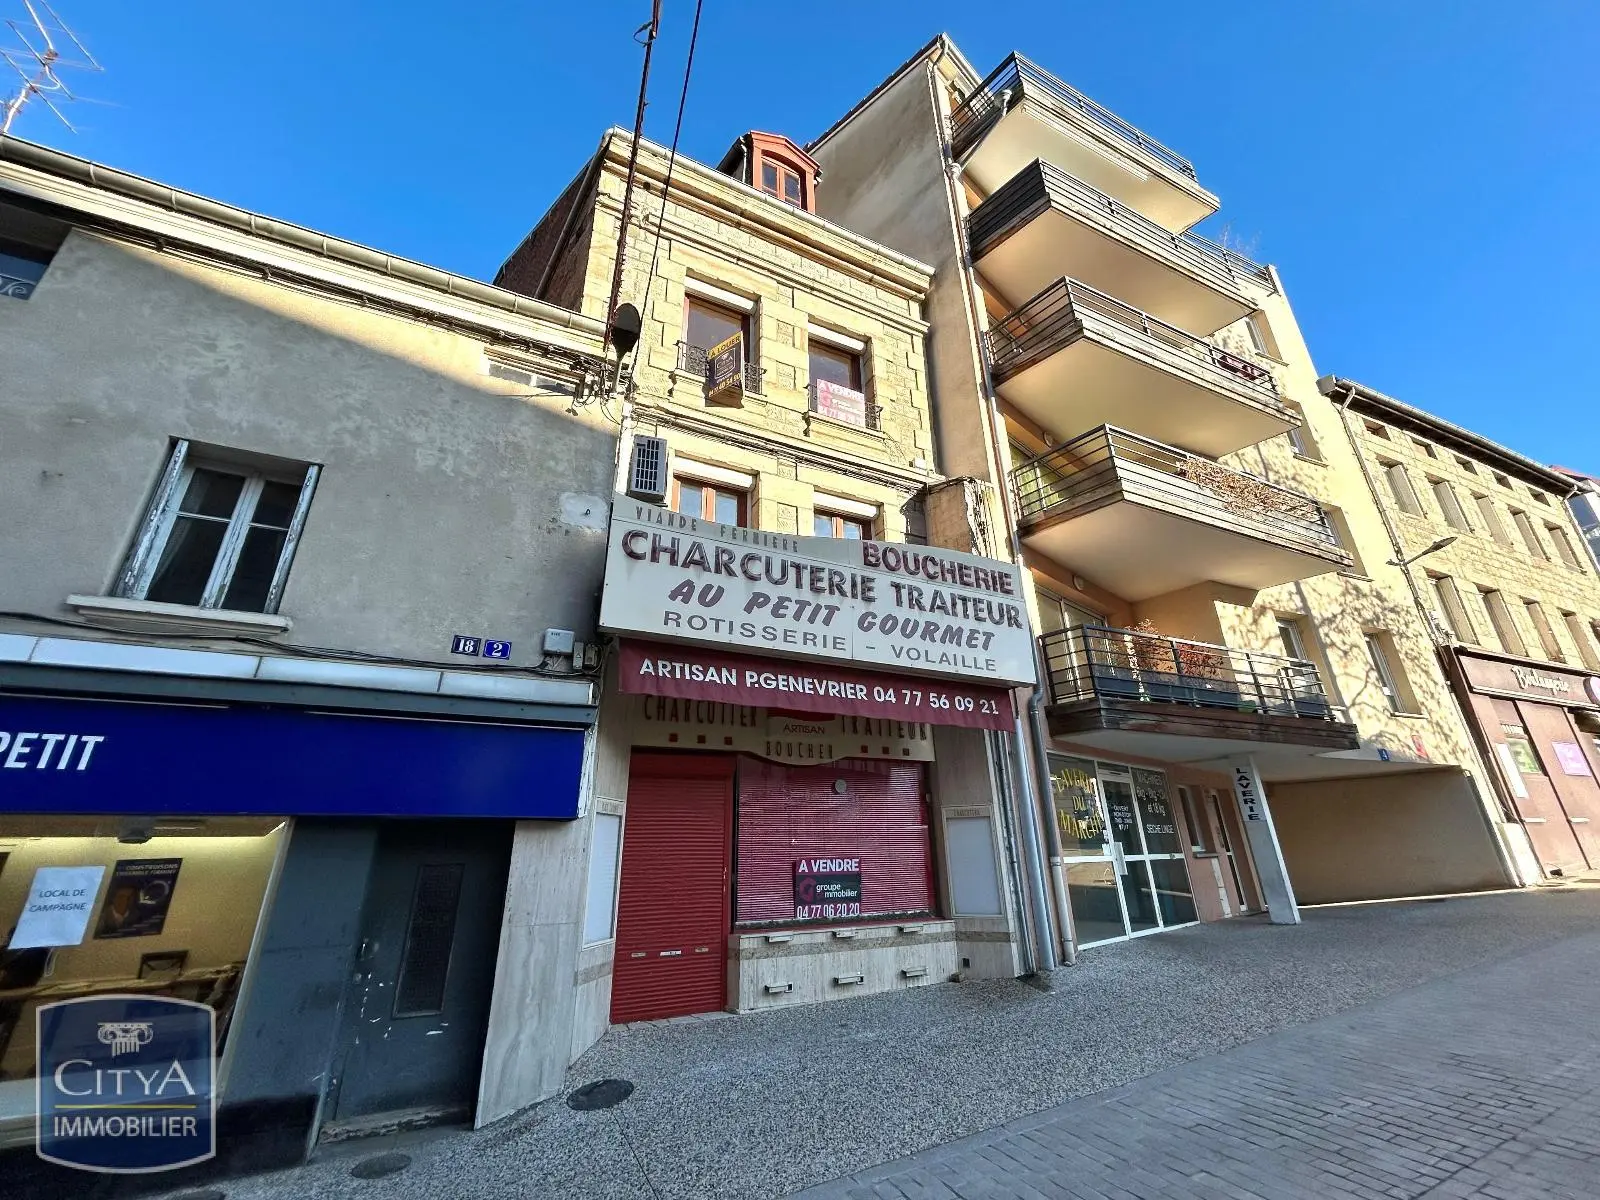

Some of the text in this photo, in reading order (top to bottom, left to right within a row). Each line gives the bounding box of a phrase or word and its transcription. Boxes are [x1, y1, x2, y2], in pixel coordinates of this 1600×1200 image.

[636, 506, 798, 552] VIANDE FERMIERE
[862, 540, 1014, 595] BOUCHERIE
[621, 529, 1023, 629] CHARCUTERIE TRAITEUR
[668, 578, 995, 651] AU PETIT GOURMET
[459, 638, 474, 653] 18
[663, 610, 846, 651] ROTISSERIE
[890, 644, 997, 672] VOLAILLE
[491, 643, 503, 657] 2
[639, 657, 999, 715] ARTISAN P.GENEVRIER 04 77 56 09 21
[783, 723, 825, 735] ARTISAN
[1235, 767, 1260, 821] LAVERIE
[1072, 795, 1087, 811] DU
[798, 858, 860, 873] A VENDRE
[39, 889, 87, 898] LOCAL DE
[816, 884, 841, 893] groupe
[29, 902, 87, 913] CAMPAGNE
[797, 903, 860, 919] 04 77 06 20 20
